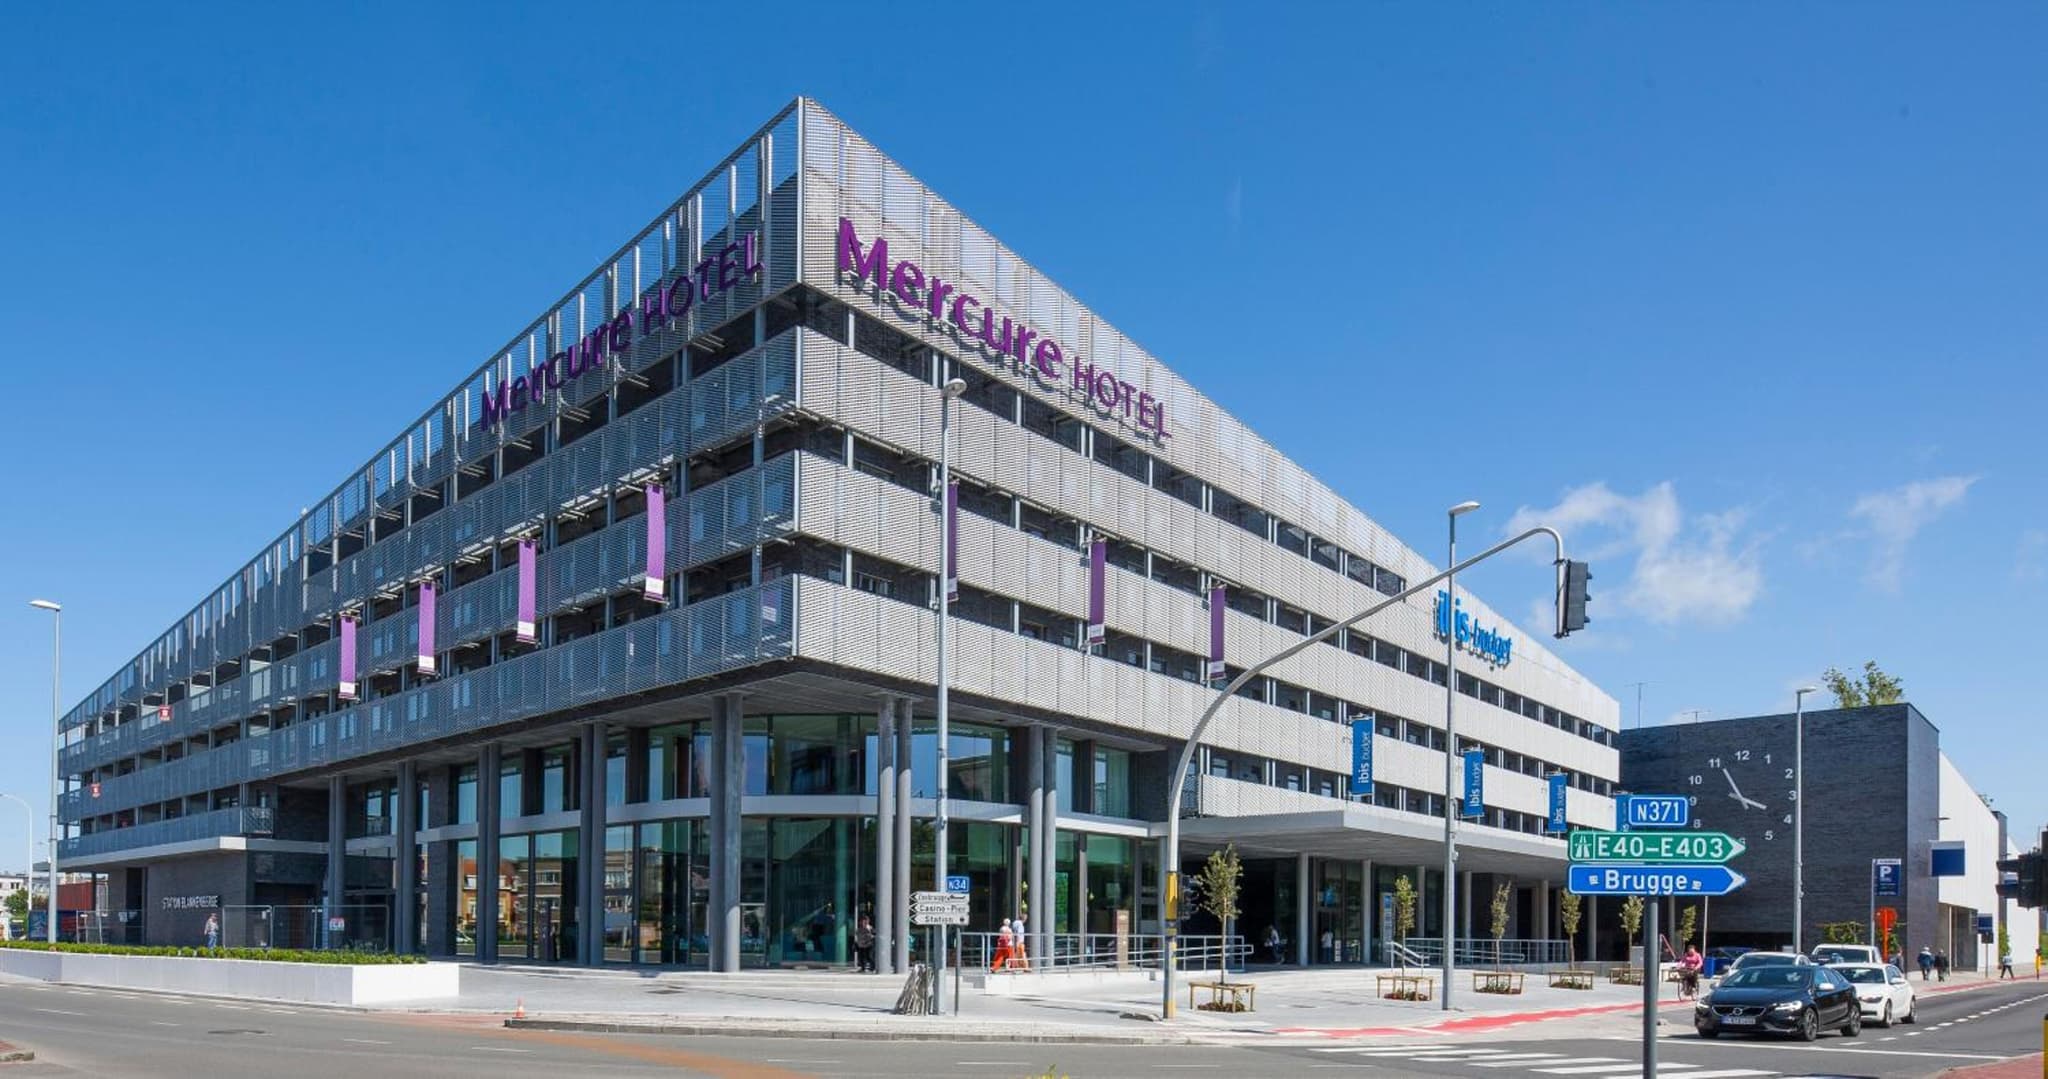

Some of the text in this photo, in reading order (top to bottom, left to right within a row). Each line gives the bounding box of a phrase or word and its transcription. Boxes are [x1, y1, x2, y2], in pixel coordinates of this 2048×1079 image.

[481, 233, 765, 432] Mercure HOTEL
[839, 216, 1172, 439] Mercure HOTEL
[1473, 618, 1512, 667] budget
[1735, 750, 1750, 760] 12
[1764, 754, 1771, 764] 1
[1708, 758, 1720, 768] 11
[1358, 762, 1369, 784] ibis
[1785, 768, 1793, 779] 2
[1688, 775, 1702, 785] 10
[1469, 788, 1480, 807] ibis
[1788, 790, 1797, 800] 3
[1689, 796, 1697, 806] 9
[1553, 807, 1564, 824] ibis
[1637, 801, 1679, 822] N371
[1693, 819, 1701, 828] 8
[1783, 814, 1792, 824] 4
[1764, 830, 1773, 840] 5
[1879, 865, 1892, 878] P
[948, 879, 967, 890] N34
[1604, 869, 1688, 895] Brugge
[919, 904, 945, 912] Casino
[924, 915, 954, 923] Station
